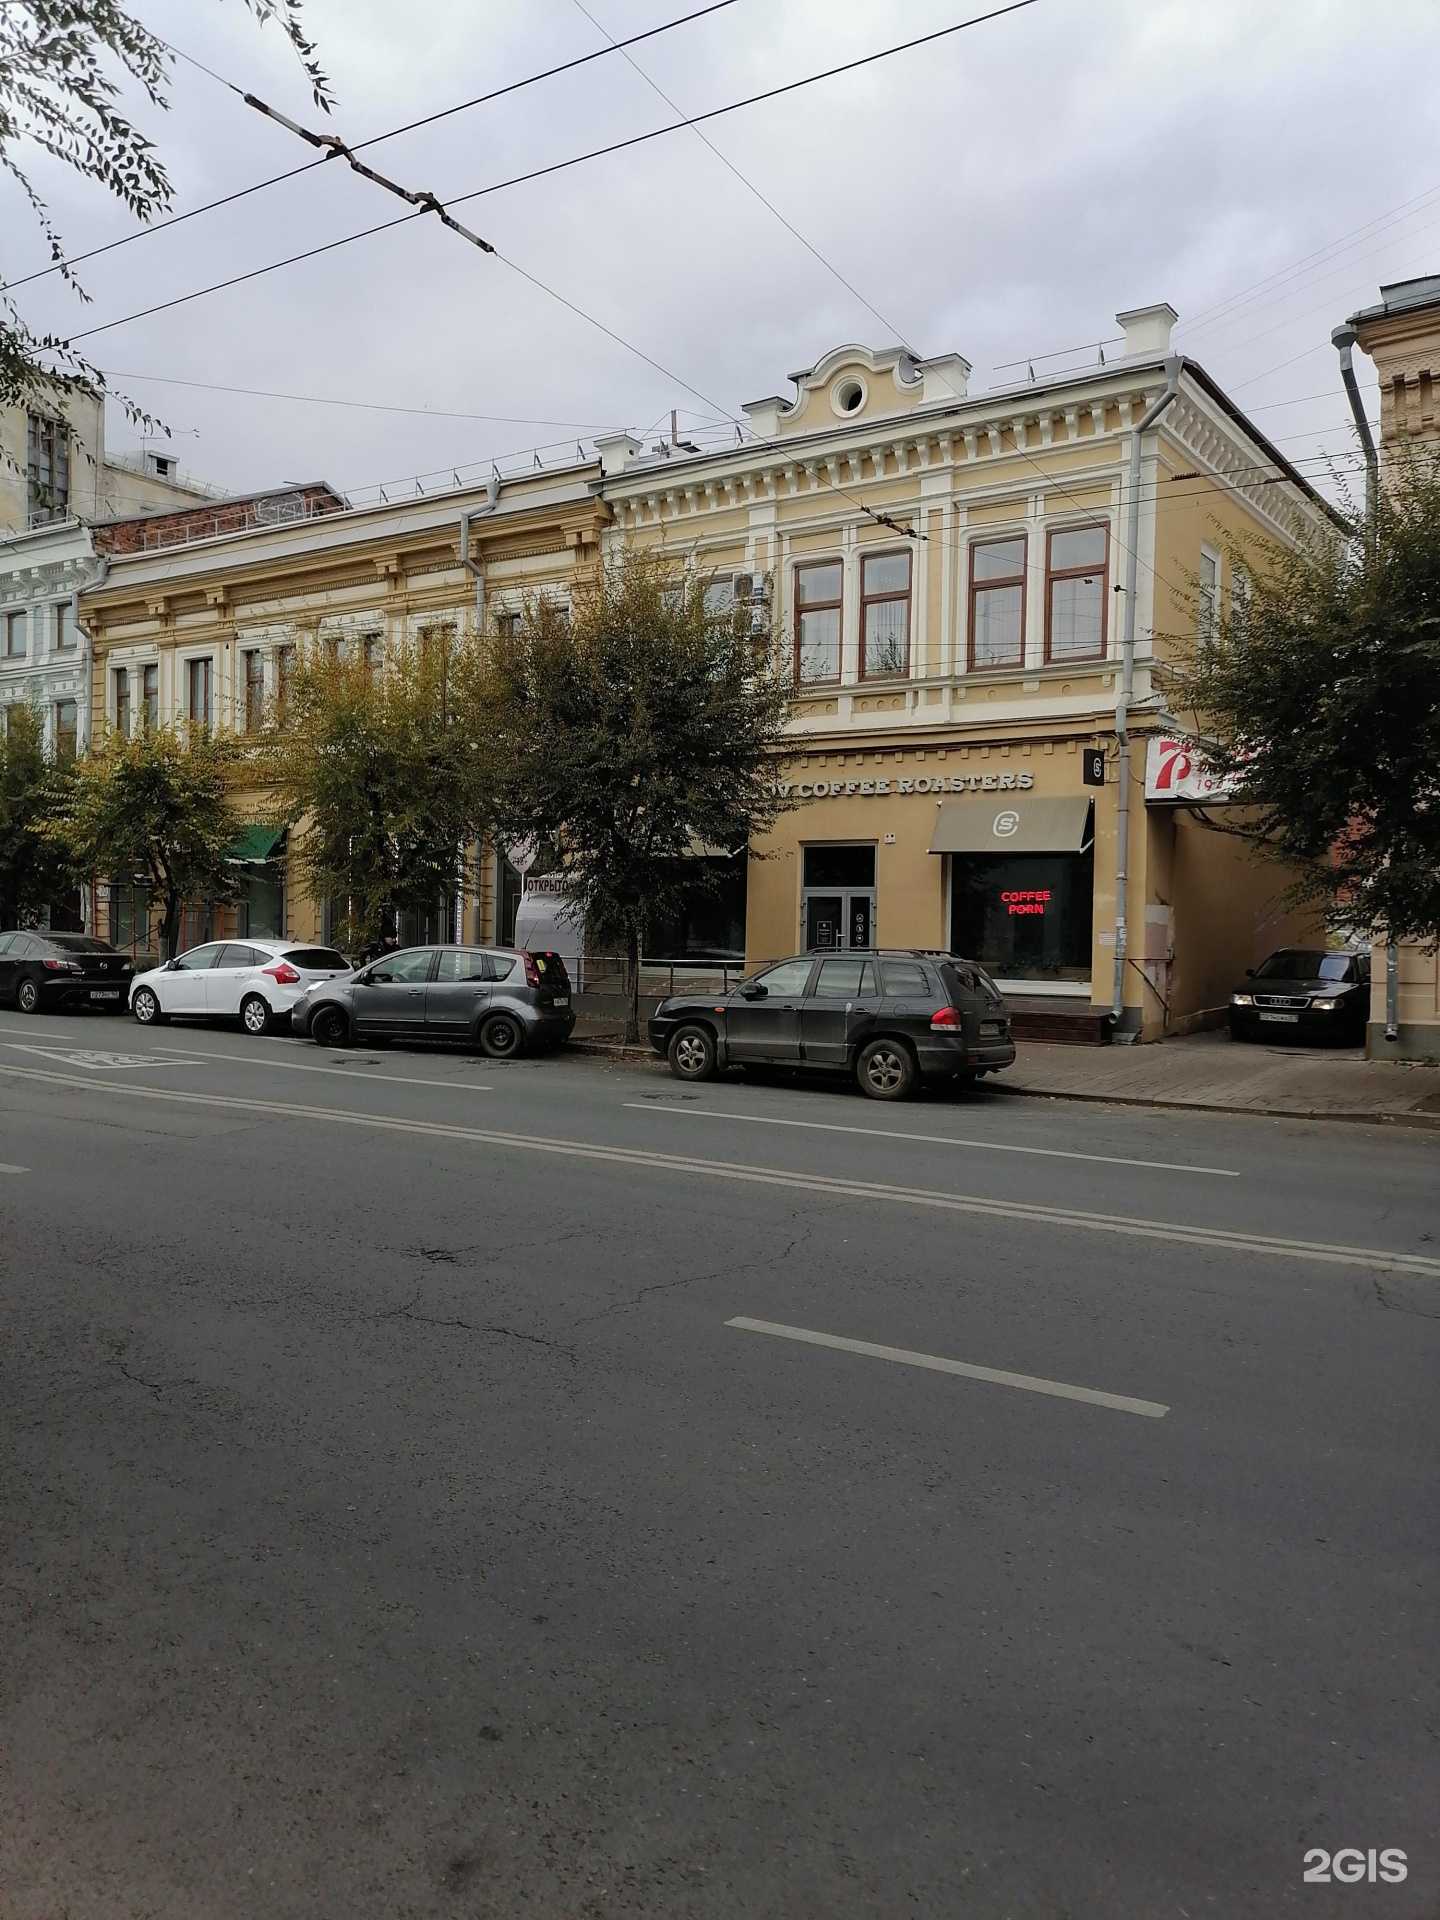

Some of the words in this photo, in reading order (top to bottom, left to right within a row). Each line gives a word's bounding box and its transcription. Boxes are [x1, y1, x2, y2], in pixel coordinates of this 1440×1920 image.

[799, 779, 891, 798] COFFEE
[896, 771, 1034, 793] ROASTERS
[1000, 890, 1051, 902] COFFEE
[1008, 904, 1045, 915] PORN
